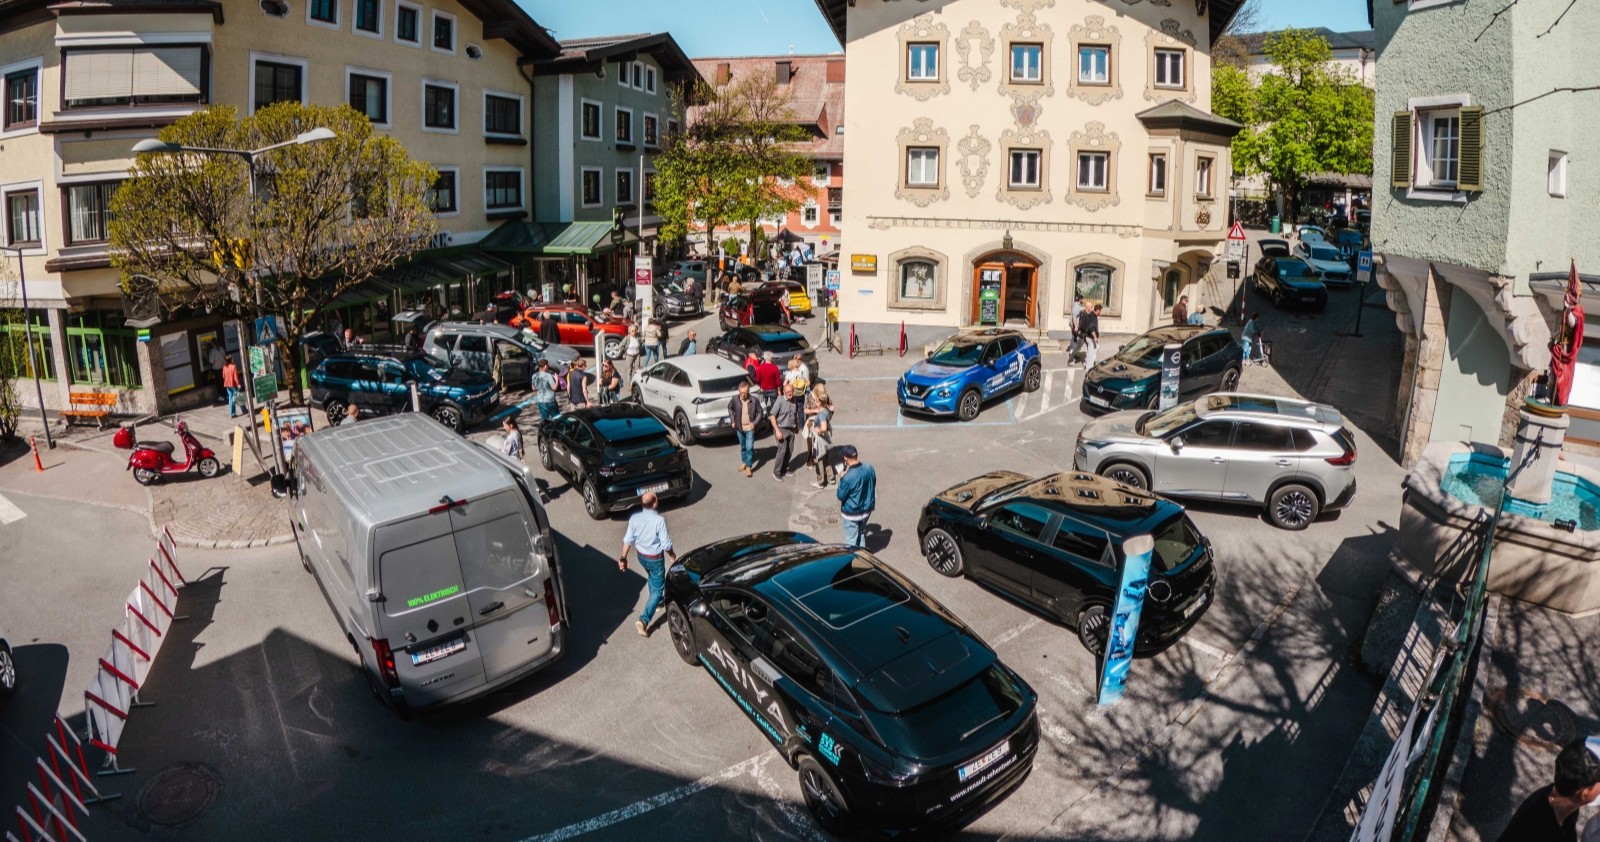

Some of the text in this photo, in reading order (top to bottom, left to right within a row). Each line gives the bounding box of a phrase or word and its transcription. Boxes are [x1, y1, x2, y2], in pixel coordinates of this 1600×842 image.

[407, 585, 459, 607] 100% ELEKTRISCH
[707, 640, 791, 737] ARIYA
[737, 694, 753, 716] GmbH
[756, 713, 783, 744] Saalfelden
[950, 753, 1018, 802] www.renault-zehentner.at
